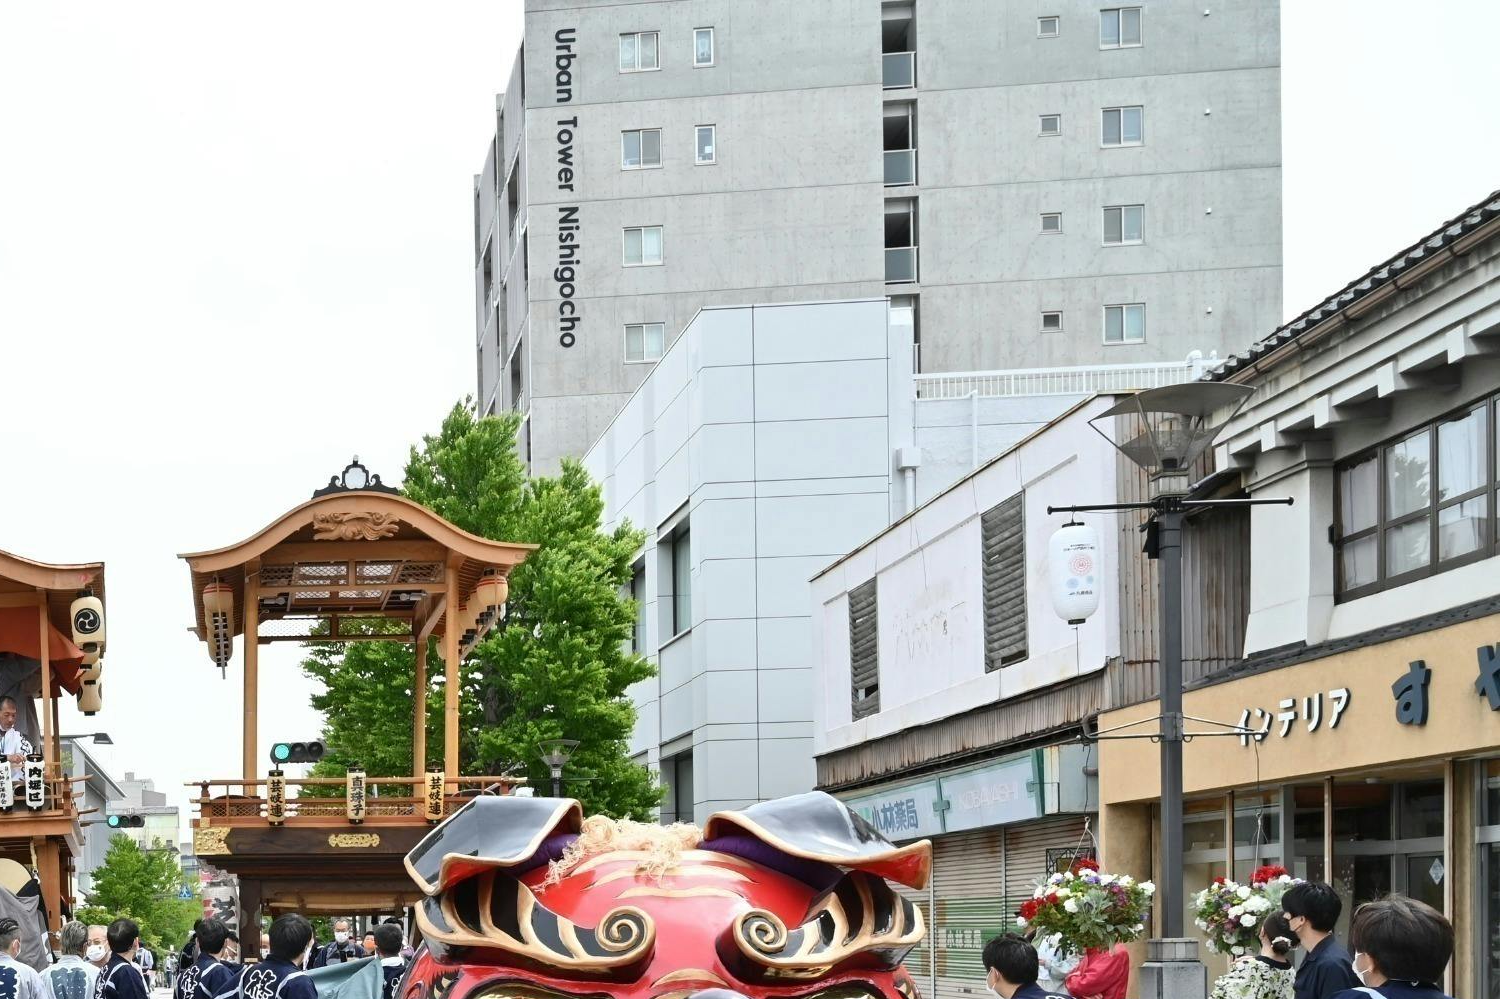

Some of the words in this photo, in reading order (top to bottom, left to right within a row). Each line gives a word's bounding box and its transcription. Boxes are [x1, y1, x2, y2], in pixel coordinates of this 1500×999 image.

[555, 28, 577, 103] Urban
[556, 116, 578, 193] Tower
[554, 207, 581, 348] Nishigocho
[1234, 687, 1352, 747] インテリア
[28, 766, 42, 802] 内堀区
[269, 779, 283, 818] 芸妓連
[428, 776, 443, 816] 芸妓連
[871, 797, 919, 835] 小林薬局
